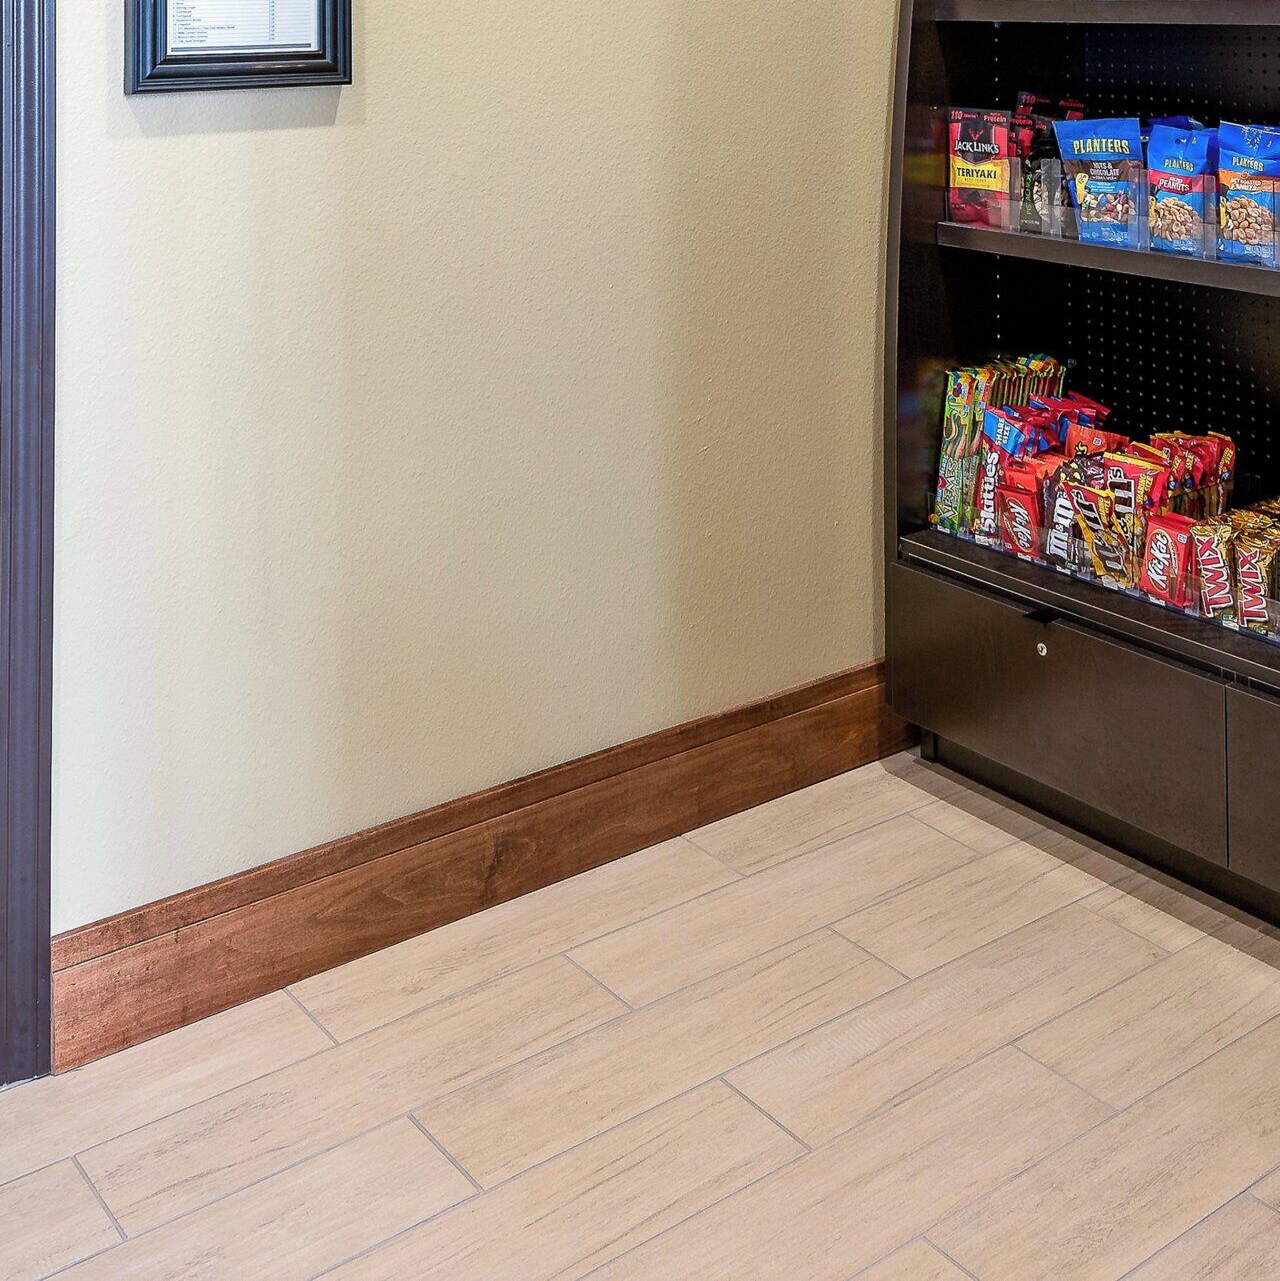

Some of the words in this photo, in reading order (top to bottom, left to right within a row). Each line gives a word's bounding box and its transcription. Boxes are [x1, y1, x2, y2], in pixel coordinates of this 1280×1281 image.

[950, 110, 963, 120] 110
[984, 115, 1007, 123] Protein
[954, 140, 973, 153] JACK
[974, 142, 999, 154] LINK'S
[1073, 139, 1131, 155] PLANTERS
[956, 167, 997, 179] TERIYAKI
[1159, 179, 1190, 191] PEANUTS
[995, 417, 1005, 446] SHARE
[1002, 423, 1011, 444] SIZE
[1144, 475, 1154, 492] SIZE
[981, 451, 999, 534] Skittles
[1195, 535, 1234, 618] TWIX
[1238, 548, 1269, 627] TWIX
